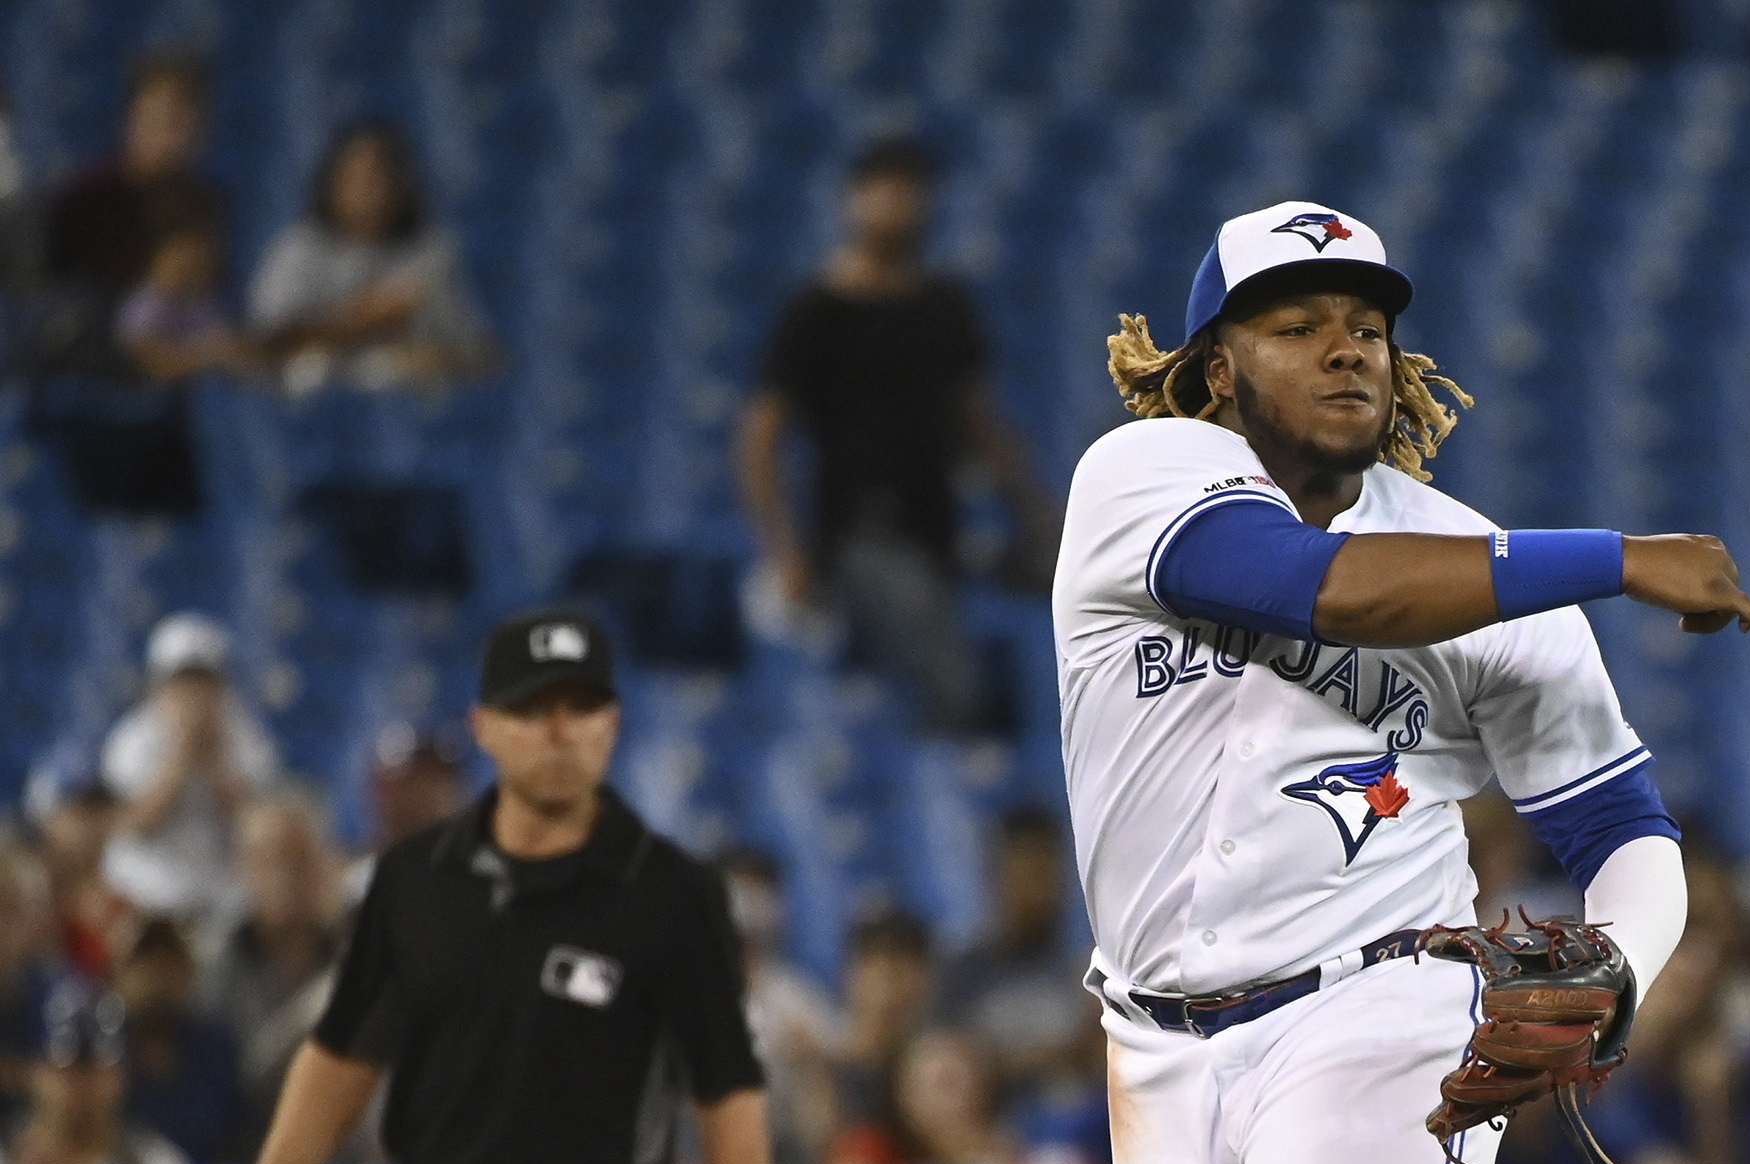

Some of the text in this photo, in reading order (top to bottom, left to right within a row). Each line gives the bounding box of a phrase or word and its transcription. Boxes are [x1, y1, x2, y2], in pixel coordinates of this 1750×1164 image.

[1135, 624, 1429, 751] BLU JAYS
[1375, 940, 1402, 962] 27
